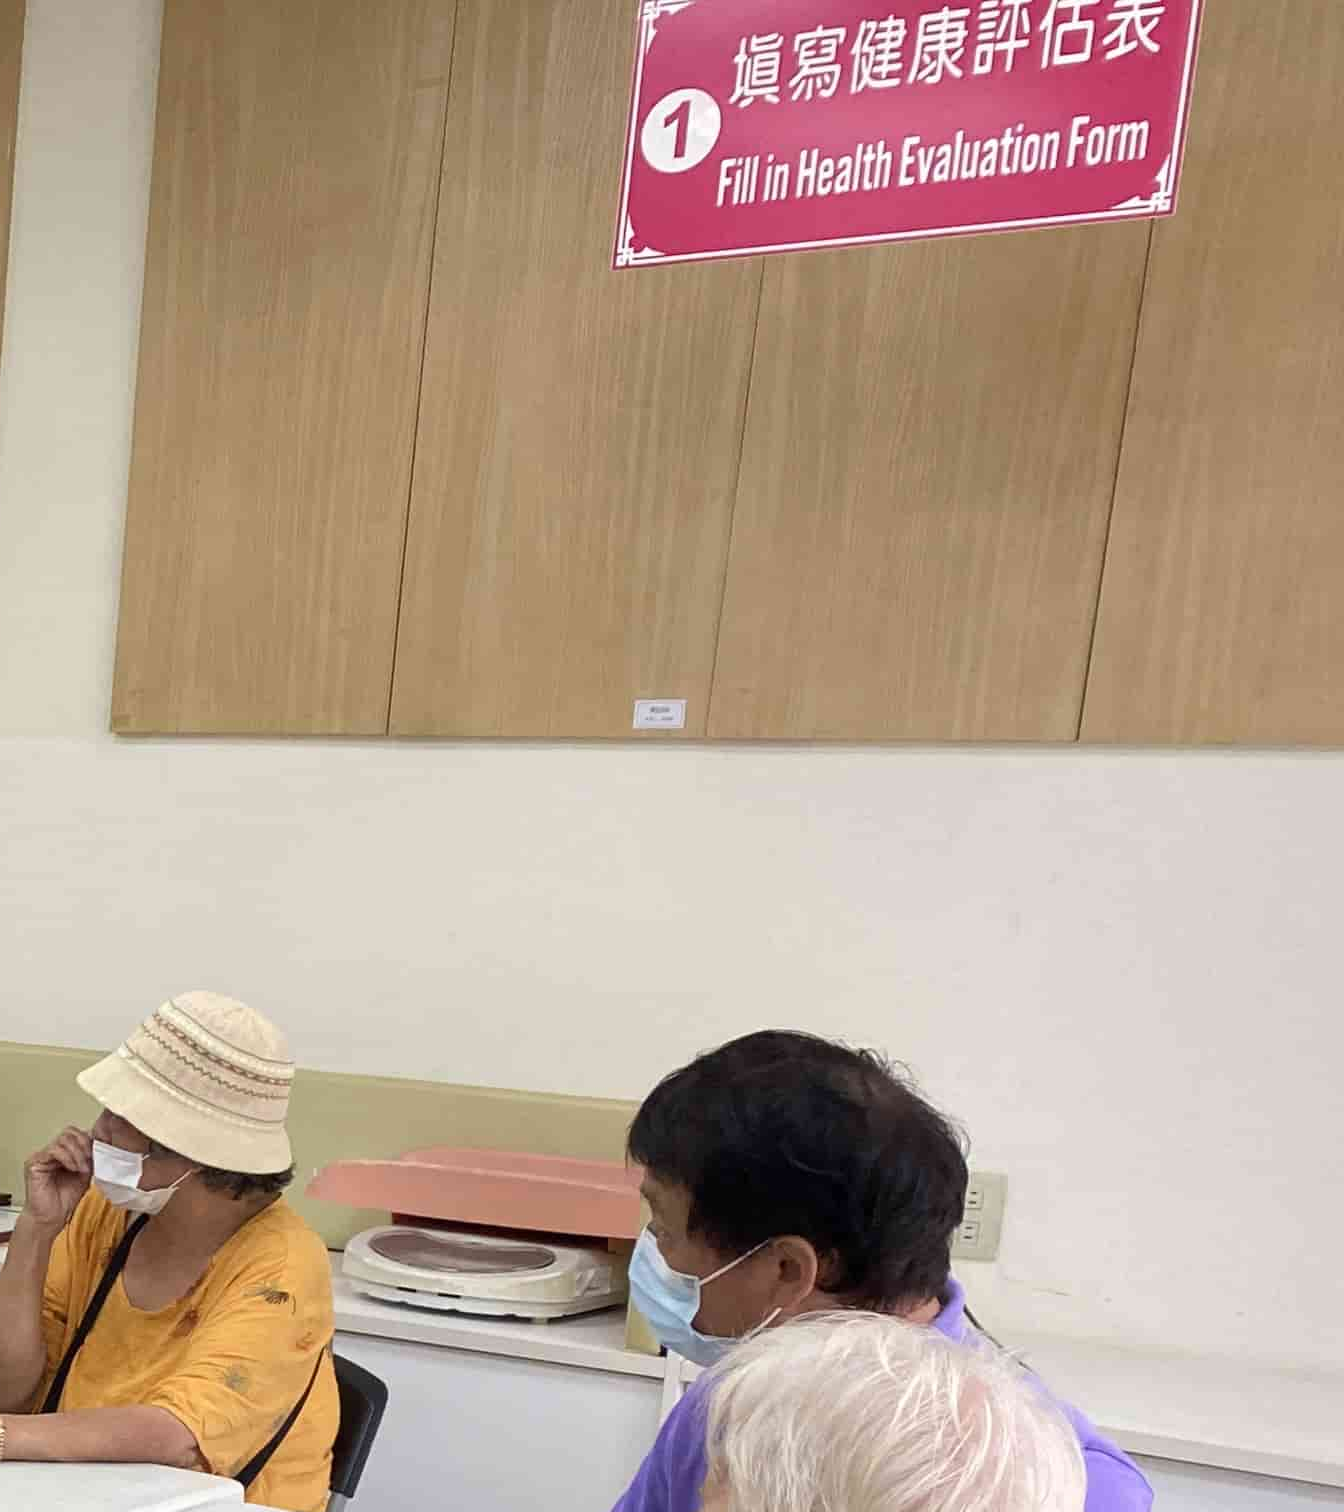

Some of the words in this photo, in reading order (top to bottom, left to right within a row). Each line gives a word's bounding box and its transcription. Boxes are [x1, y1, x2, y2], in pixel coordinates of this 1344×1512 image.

[715, 154, 760, 208] Fill
[761, 153, 790, 202] in
[794, 140, 893, 199] Health
[897, 122, 1061, 187] Evaluation
[1065, 114, 1150, 168] Form
